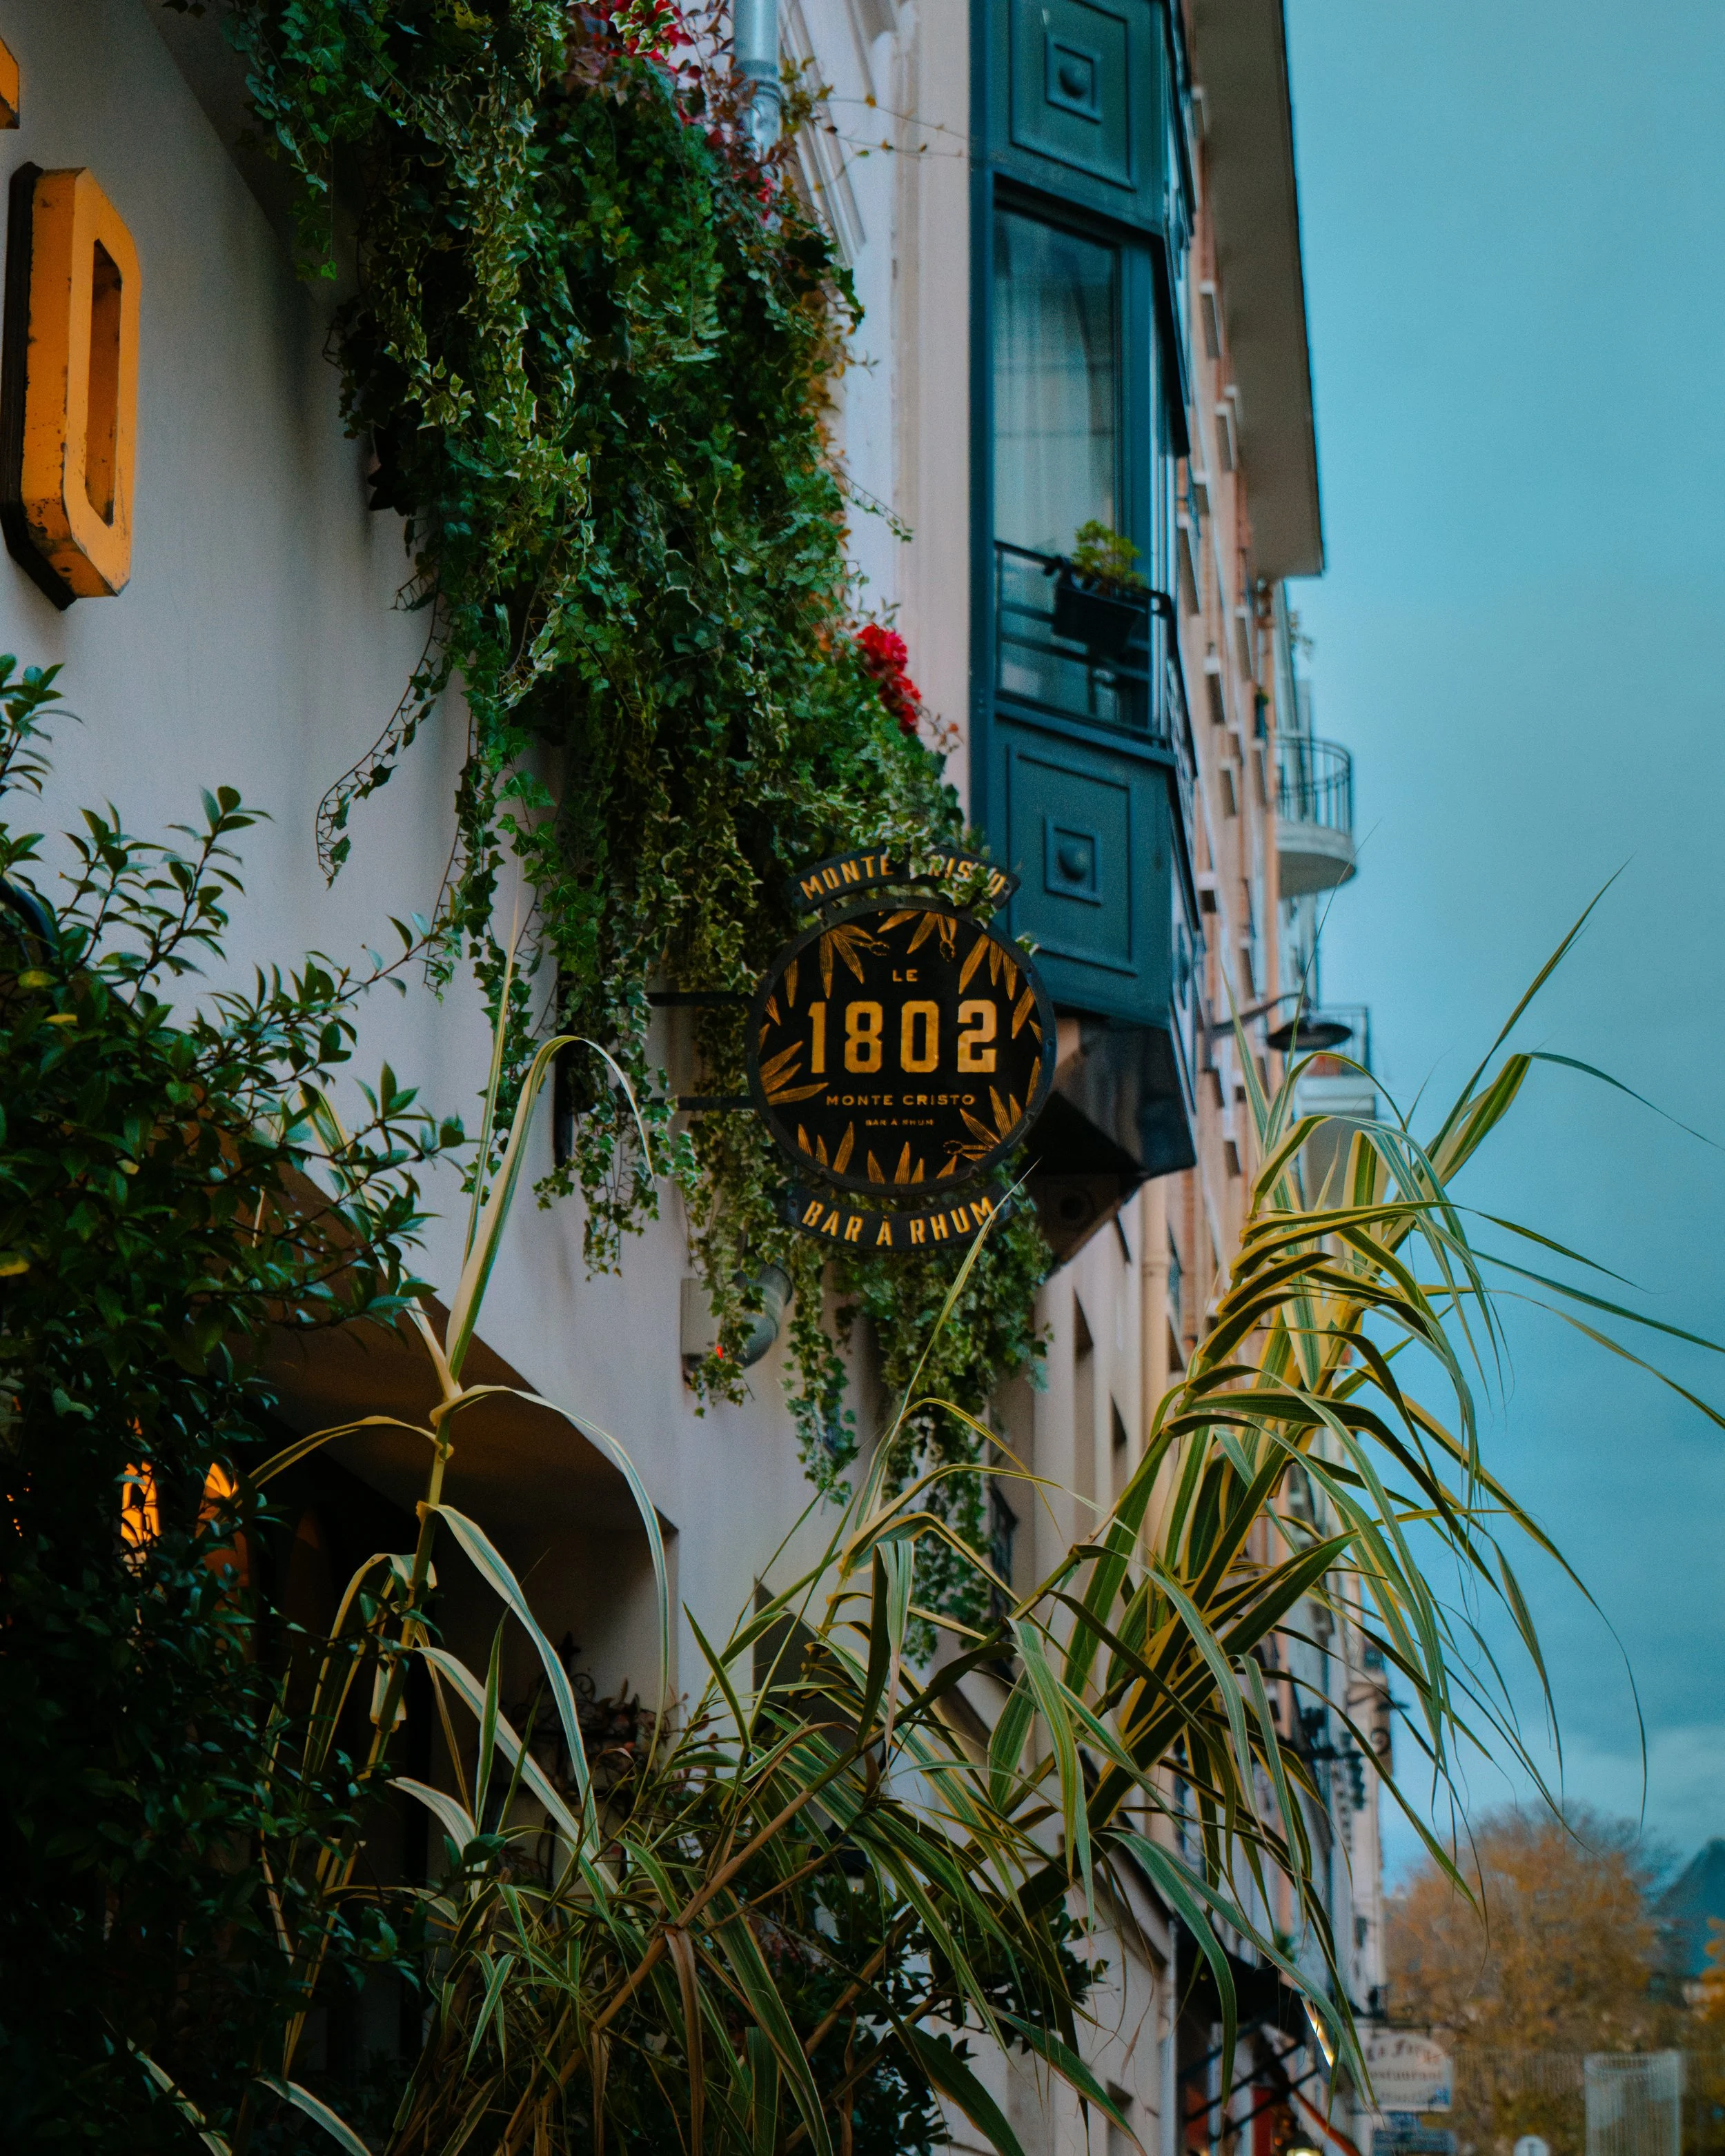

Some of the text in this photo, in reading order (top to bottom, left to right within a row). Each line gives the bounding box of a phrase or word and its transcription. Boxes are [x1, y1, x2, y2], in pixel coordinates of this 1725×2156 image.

[800, 854, 895, 900] MONTE
[892, 969, 918, 982] LE
[808, 1000, 997, 1074] 1802
[826, 1094, 976, 1106] MONTE CRISTO
[801, 1200, 862, 1242] BAR
[909, 1196, 996, 1245] RHUM
[1366, 2070, 1442, 2081] estaurant
